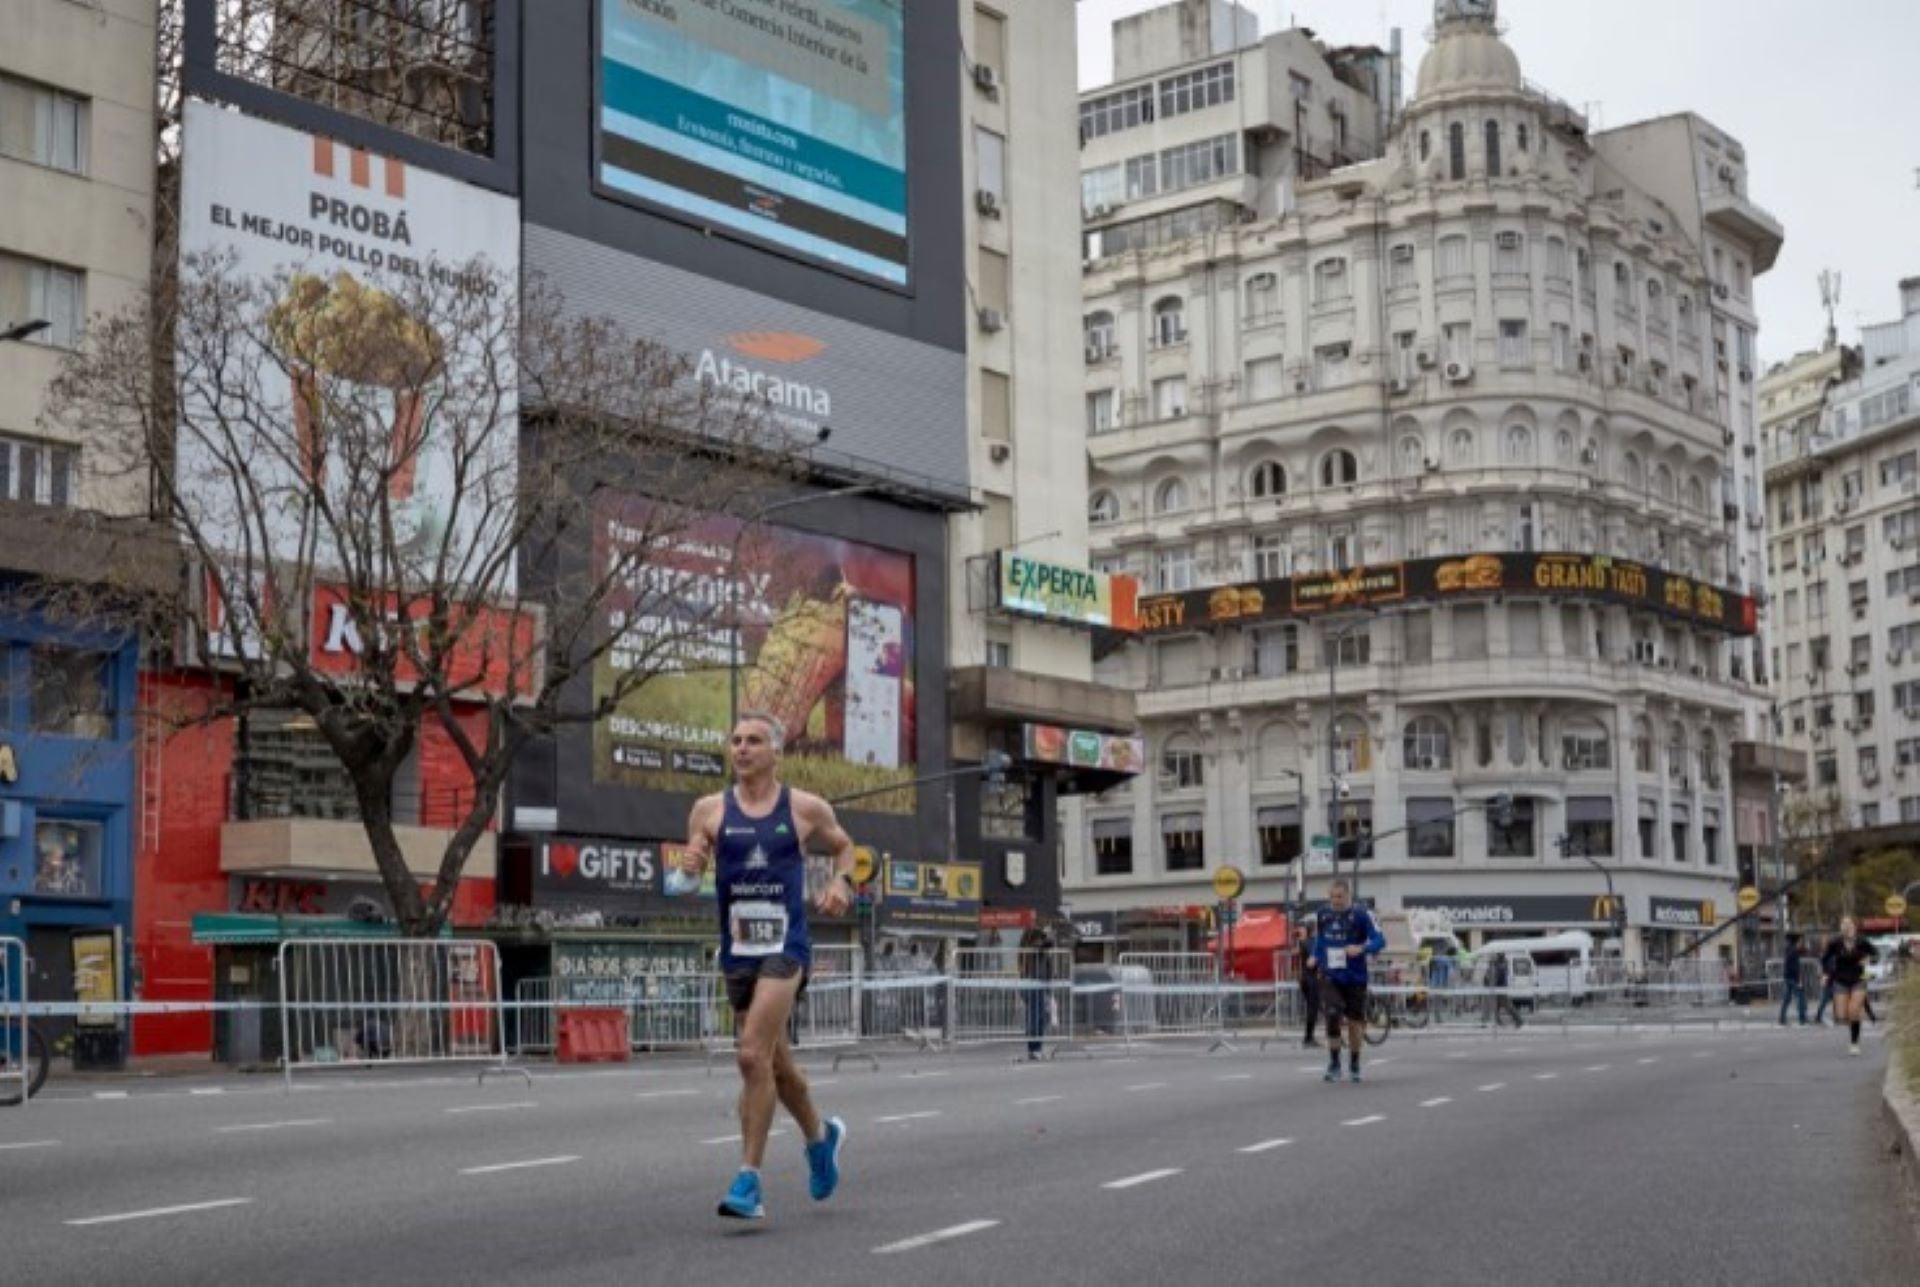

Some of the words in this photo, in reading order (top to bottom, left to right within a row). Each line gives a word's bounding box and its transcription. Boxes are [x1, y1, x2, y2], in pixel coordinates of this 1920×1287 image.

[210, 203, 237, 229] EL
[241, 211, 314, 249] MEJOR
[318, 233, 384, 267] POLLO
[387, 253, 426, 282] DEL
[309, 191, 411, 246] PROBÁ
[1011, 558, 1098, 602] EXPERTA
[1534, 563, 1607, 590] GRAND
